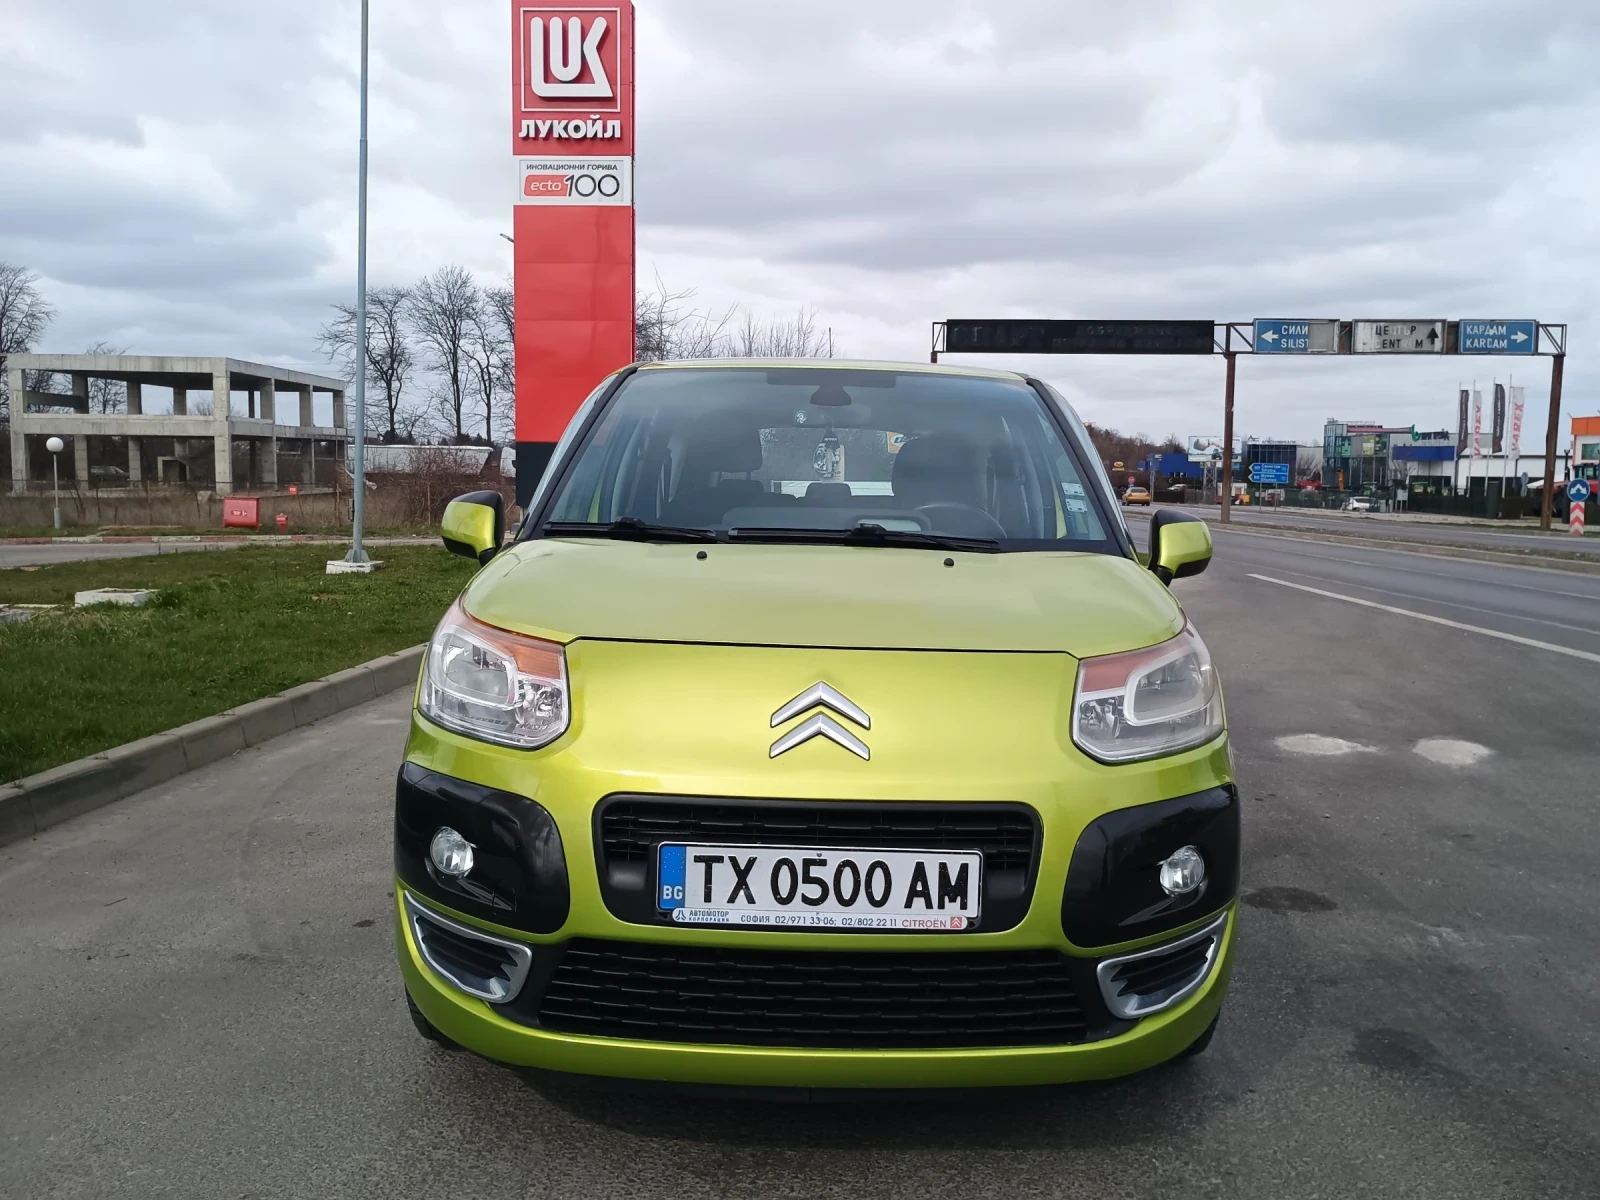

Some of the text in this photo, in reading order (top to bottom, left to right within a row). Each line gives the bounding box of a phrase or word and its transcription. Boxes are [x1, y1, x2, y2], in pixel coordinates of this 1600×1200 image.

[518, 114, 621, 139] ЛУКОЙЛ
[1466, 325, 1507, 336] КАРДАМ
[1466, 339, 1508, 349] KARDAM
[694, 855, 969, 911] TX 0500 AM
[663, 885, 683, 900] BG
[689, 910, 730, 918] АВТОМОТОР
[741, 914, 770, 923] СОФИЯ
